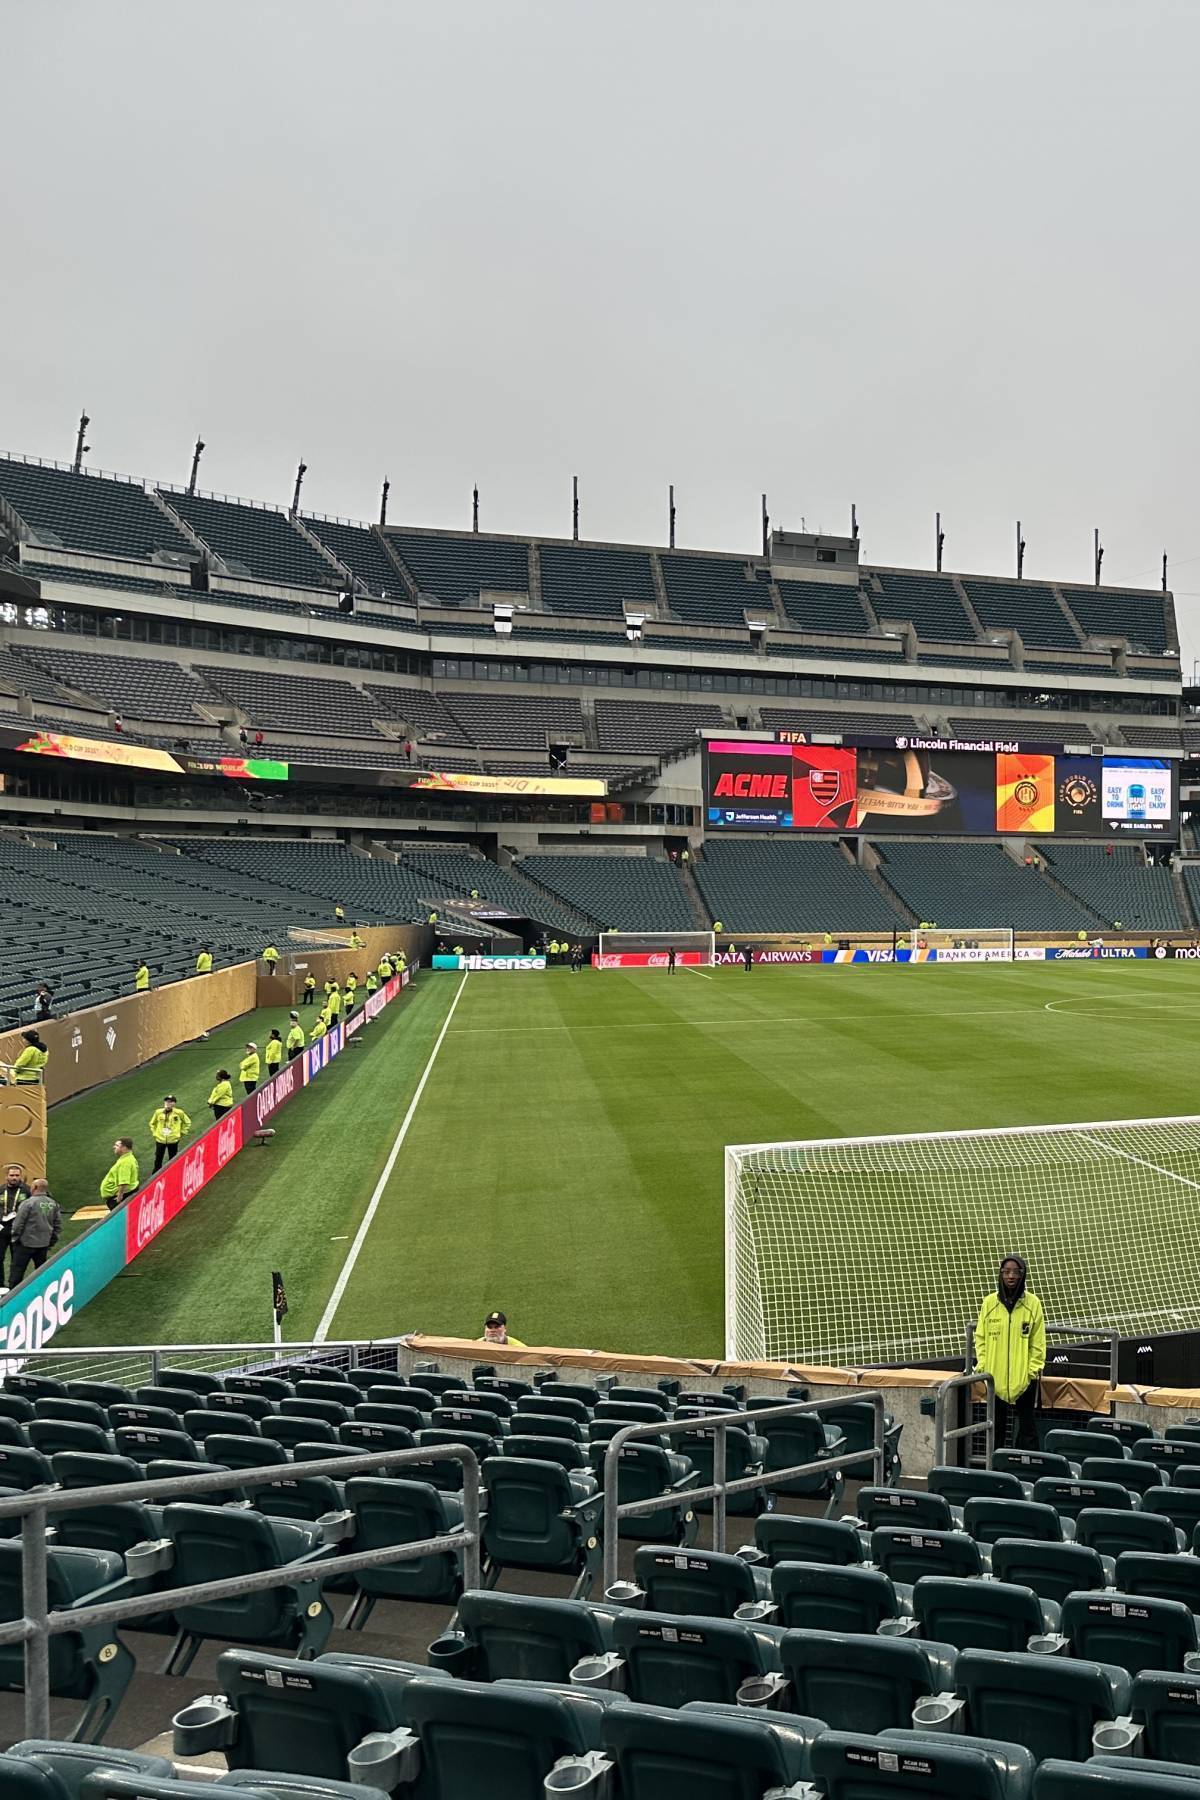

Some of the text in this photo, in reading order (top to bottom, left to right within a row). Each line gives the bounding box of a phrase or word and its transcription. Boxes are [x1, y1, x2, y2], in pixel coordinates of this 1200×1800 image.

[780, 732, 806, 743] FIFA
[910, 738, 1019, 752] Lincoln Financial Field
[759, 951, 812, 962] AIRWAYS
[865, 950, 897, 962] VISA
[939, 951, 966, 960] BANK
[969, 951, 982, 959] OF
[1101, 949, 1136, 958] ULTRA
[458, 955, 546, 970] Hisense
[256, 1082, 275, 1127] QATAR
[217, 1116, 236, 1167] Coca-Cola
[182, 1143, 205, 1201] Coca-Cola
[137, 1178, 165, 1248] Coca-Cola
[105, 1647, 112, 1658] 8
[861, 1754, 877, 1763] HELP?
